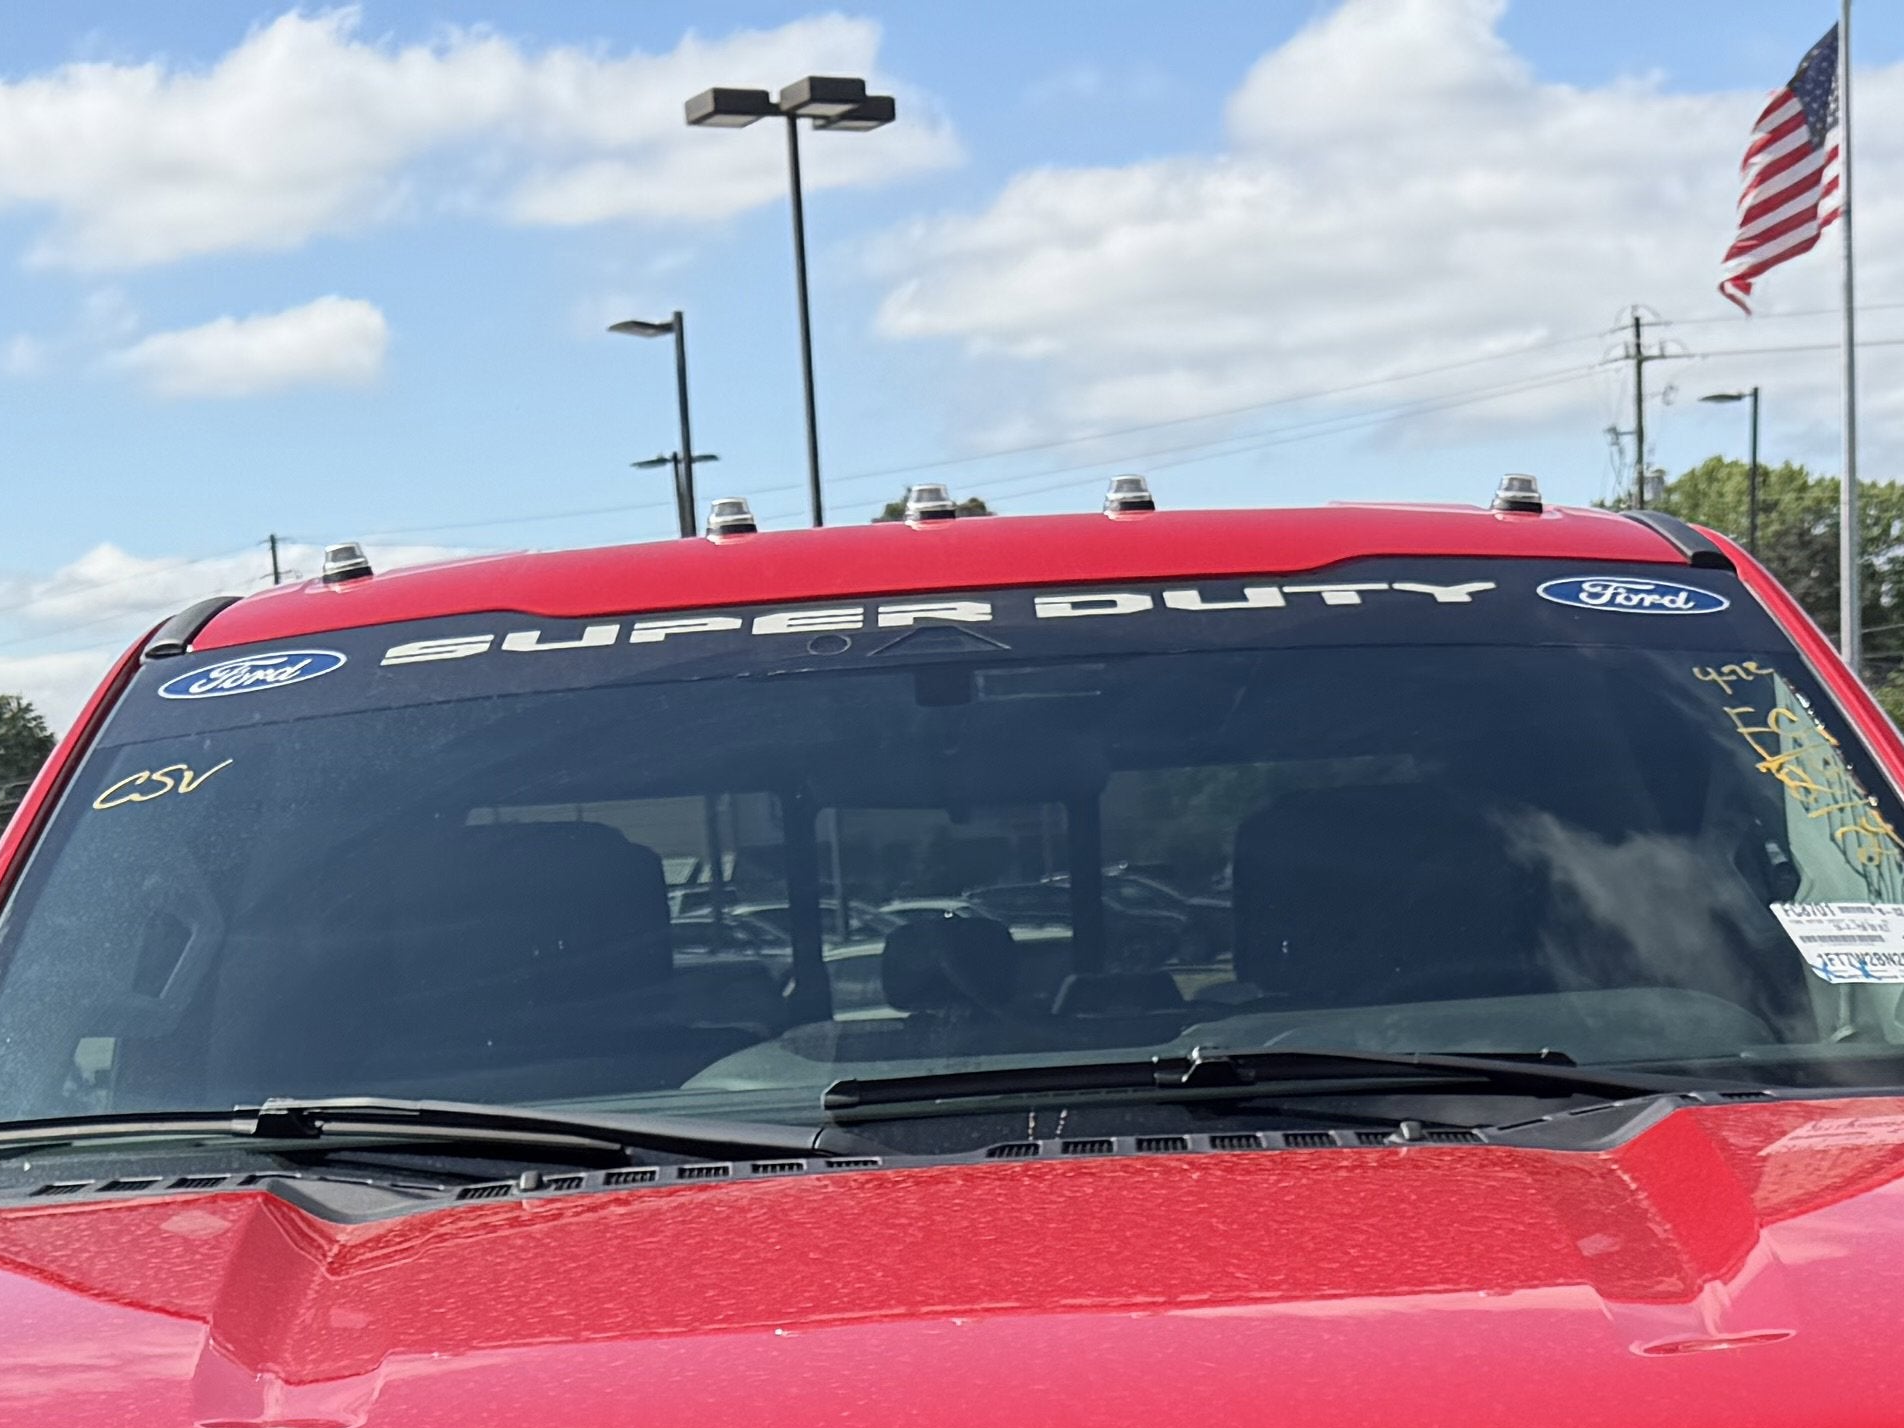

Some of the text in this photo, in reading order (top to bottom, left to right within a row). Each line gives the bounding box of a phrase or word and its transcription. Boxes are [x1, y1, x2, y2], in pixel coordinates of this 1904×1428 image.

[1578, 580, 1696, 610] Ford
[380, 581, 1497, 667] SUPER DUTY
[188, 656, 313, 695] Ford
